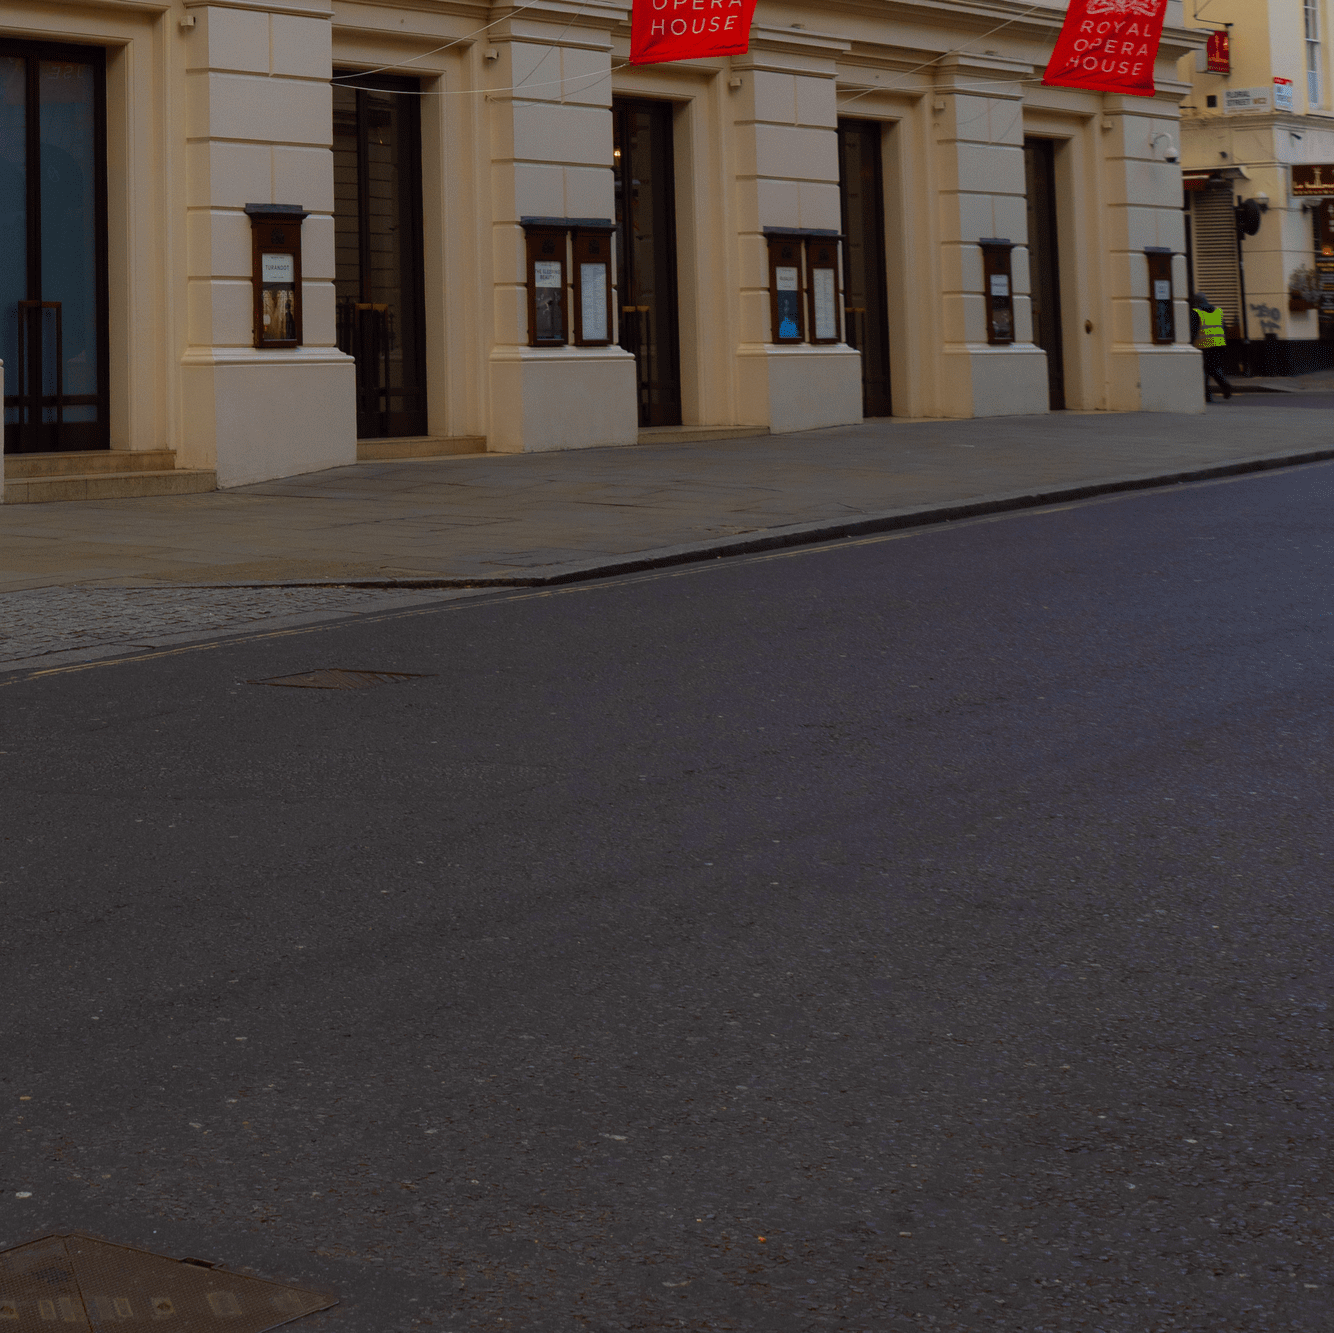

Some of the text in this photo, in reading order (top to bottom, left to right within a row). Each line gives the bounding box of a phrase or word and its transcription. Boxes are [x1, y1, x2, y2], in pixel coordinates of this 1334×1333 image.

[651, 15, 738, 36] HOUSE
[1080, 19, 1152, 37] ROYAL
[1073, 38, 1148, 56] OPERA
[1066, 55, 1143, 75] HOUSE
